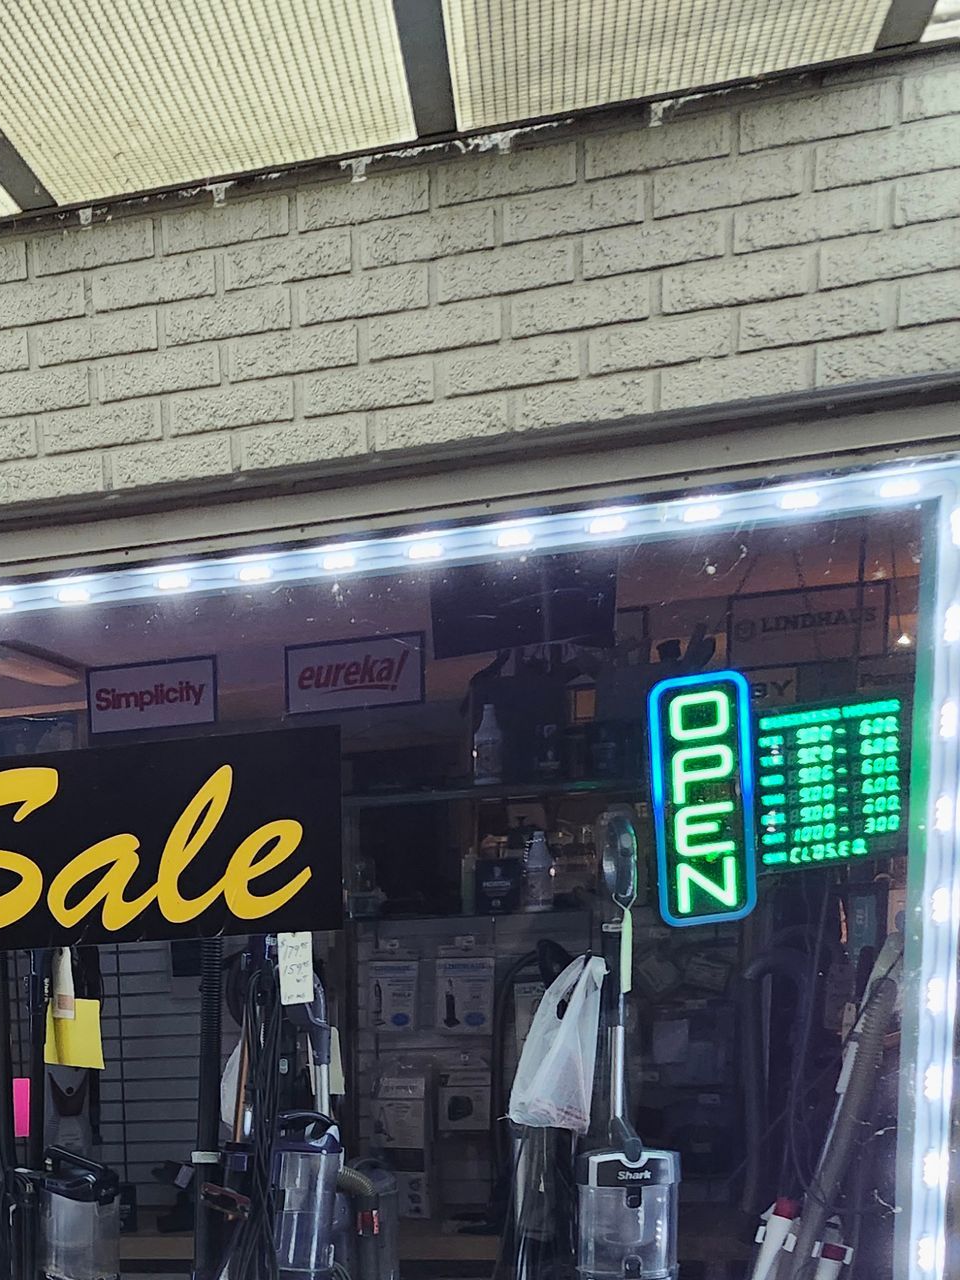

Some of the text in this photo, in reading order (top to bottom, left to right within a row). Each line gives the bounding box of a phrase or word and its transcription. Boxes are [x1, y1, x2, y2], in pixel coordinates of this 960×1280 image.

[296, 649, 410, 692] eureka!
[95, 681, 206, 712] Simplicity
[669, 690, 738, 914] OPEN
[617, 1169, 652, 1181] Shark
